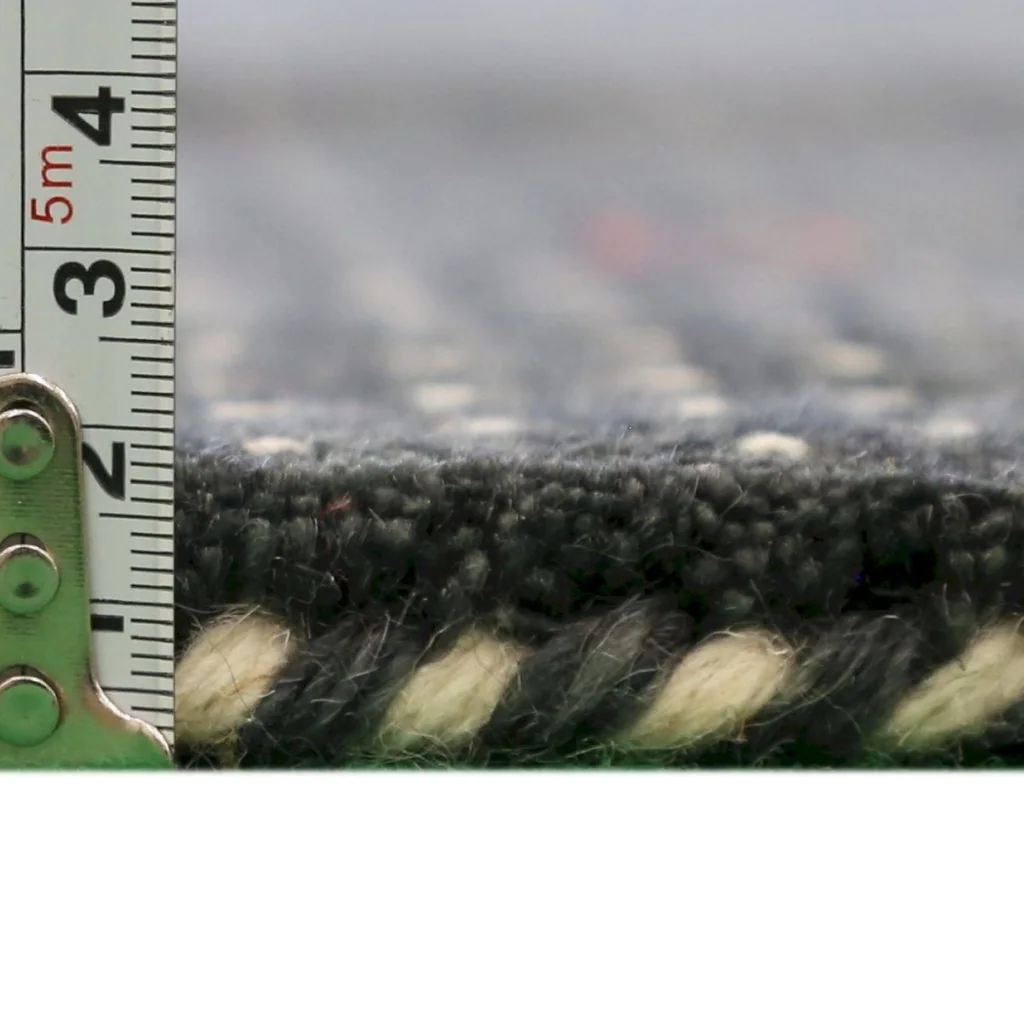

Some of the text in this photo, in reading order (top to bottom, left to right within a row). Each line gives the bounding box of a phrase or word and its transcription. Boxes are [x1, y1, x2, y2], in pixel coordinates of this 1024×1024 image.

[51, 86, 126, 146] 4
[31, 144, 74, 225] 5m
[53, 259, 126, 318] 3
